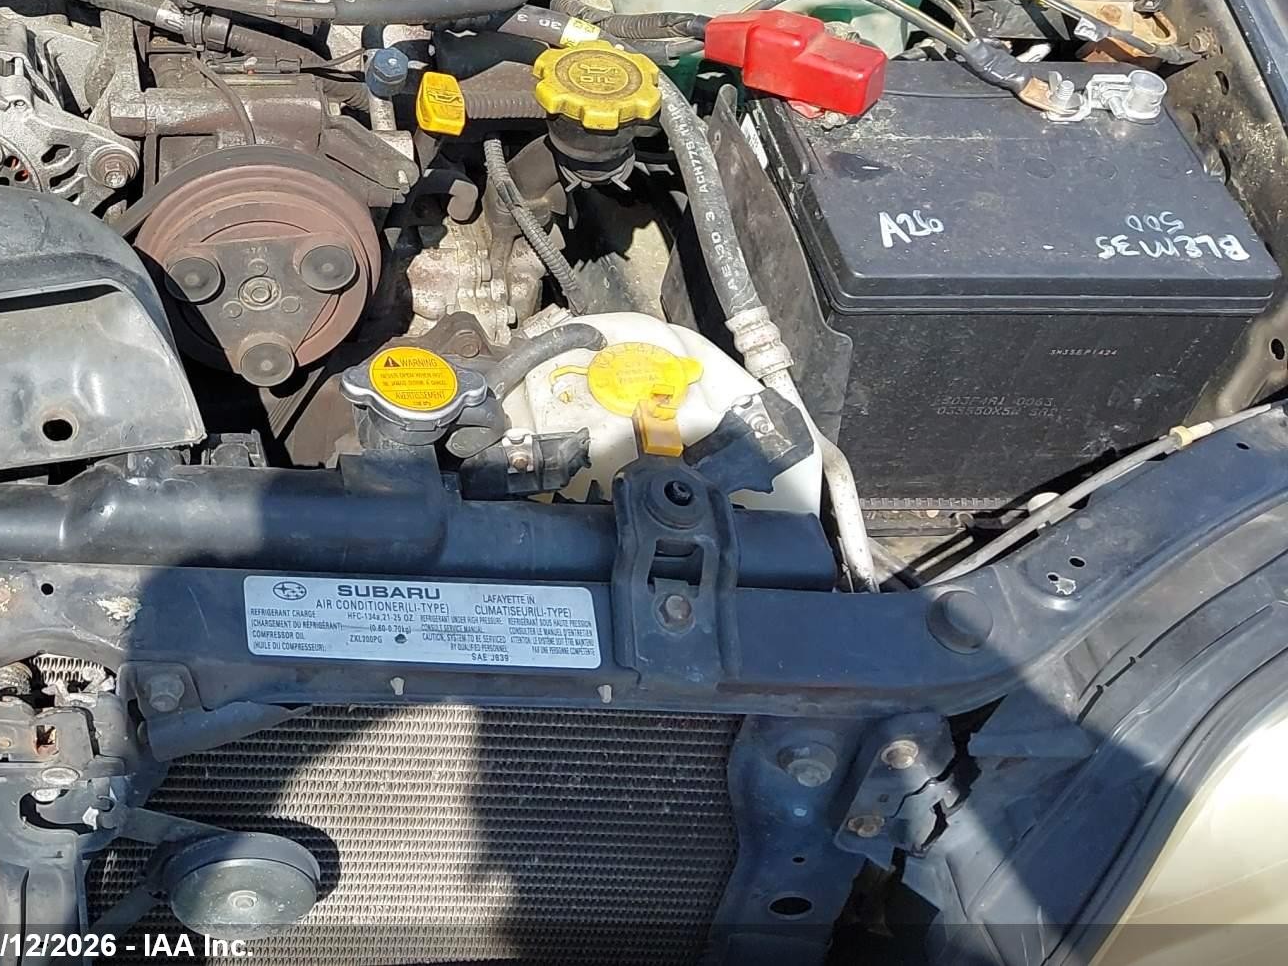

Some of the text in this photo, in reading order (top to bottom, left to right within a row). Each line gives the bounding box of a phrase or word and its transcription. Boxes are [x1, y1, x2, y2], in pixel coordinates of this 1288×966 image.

[580, 75, 616, 84] OIL
[1124, 211, 1185, 233] 500
[400, 358, 438, 367] WARNING
[338, 584, 440, 600] SUBARU
[483, 594, 525, 604] LAFAYETTE
[316, 599, 332, 609] AIR
[250, 608, 316, 619] REFRIGERANT CHARGE
[293, 620, 301, 629] DU
[252, 630, 294, 639] COMPRESSOR
[273, 642, 281, 650] DU
[472, 653, 488, 661] SAE
